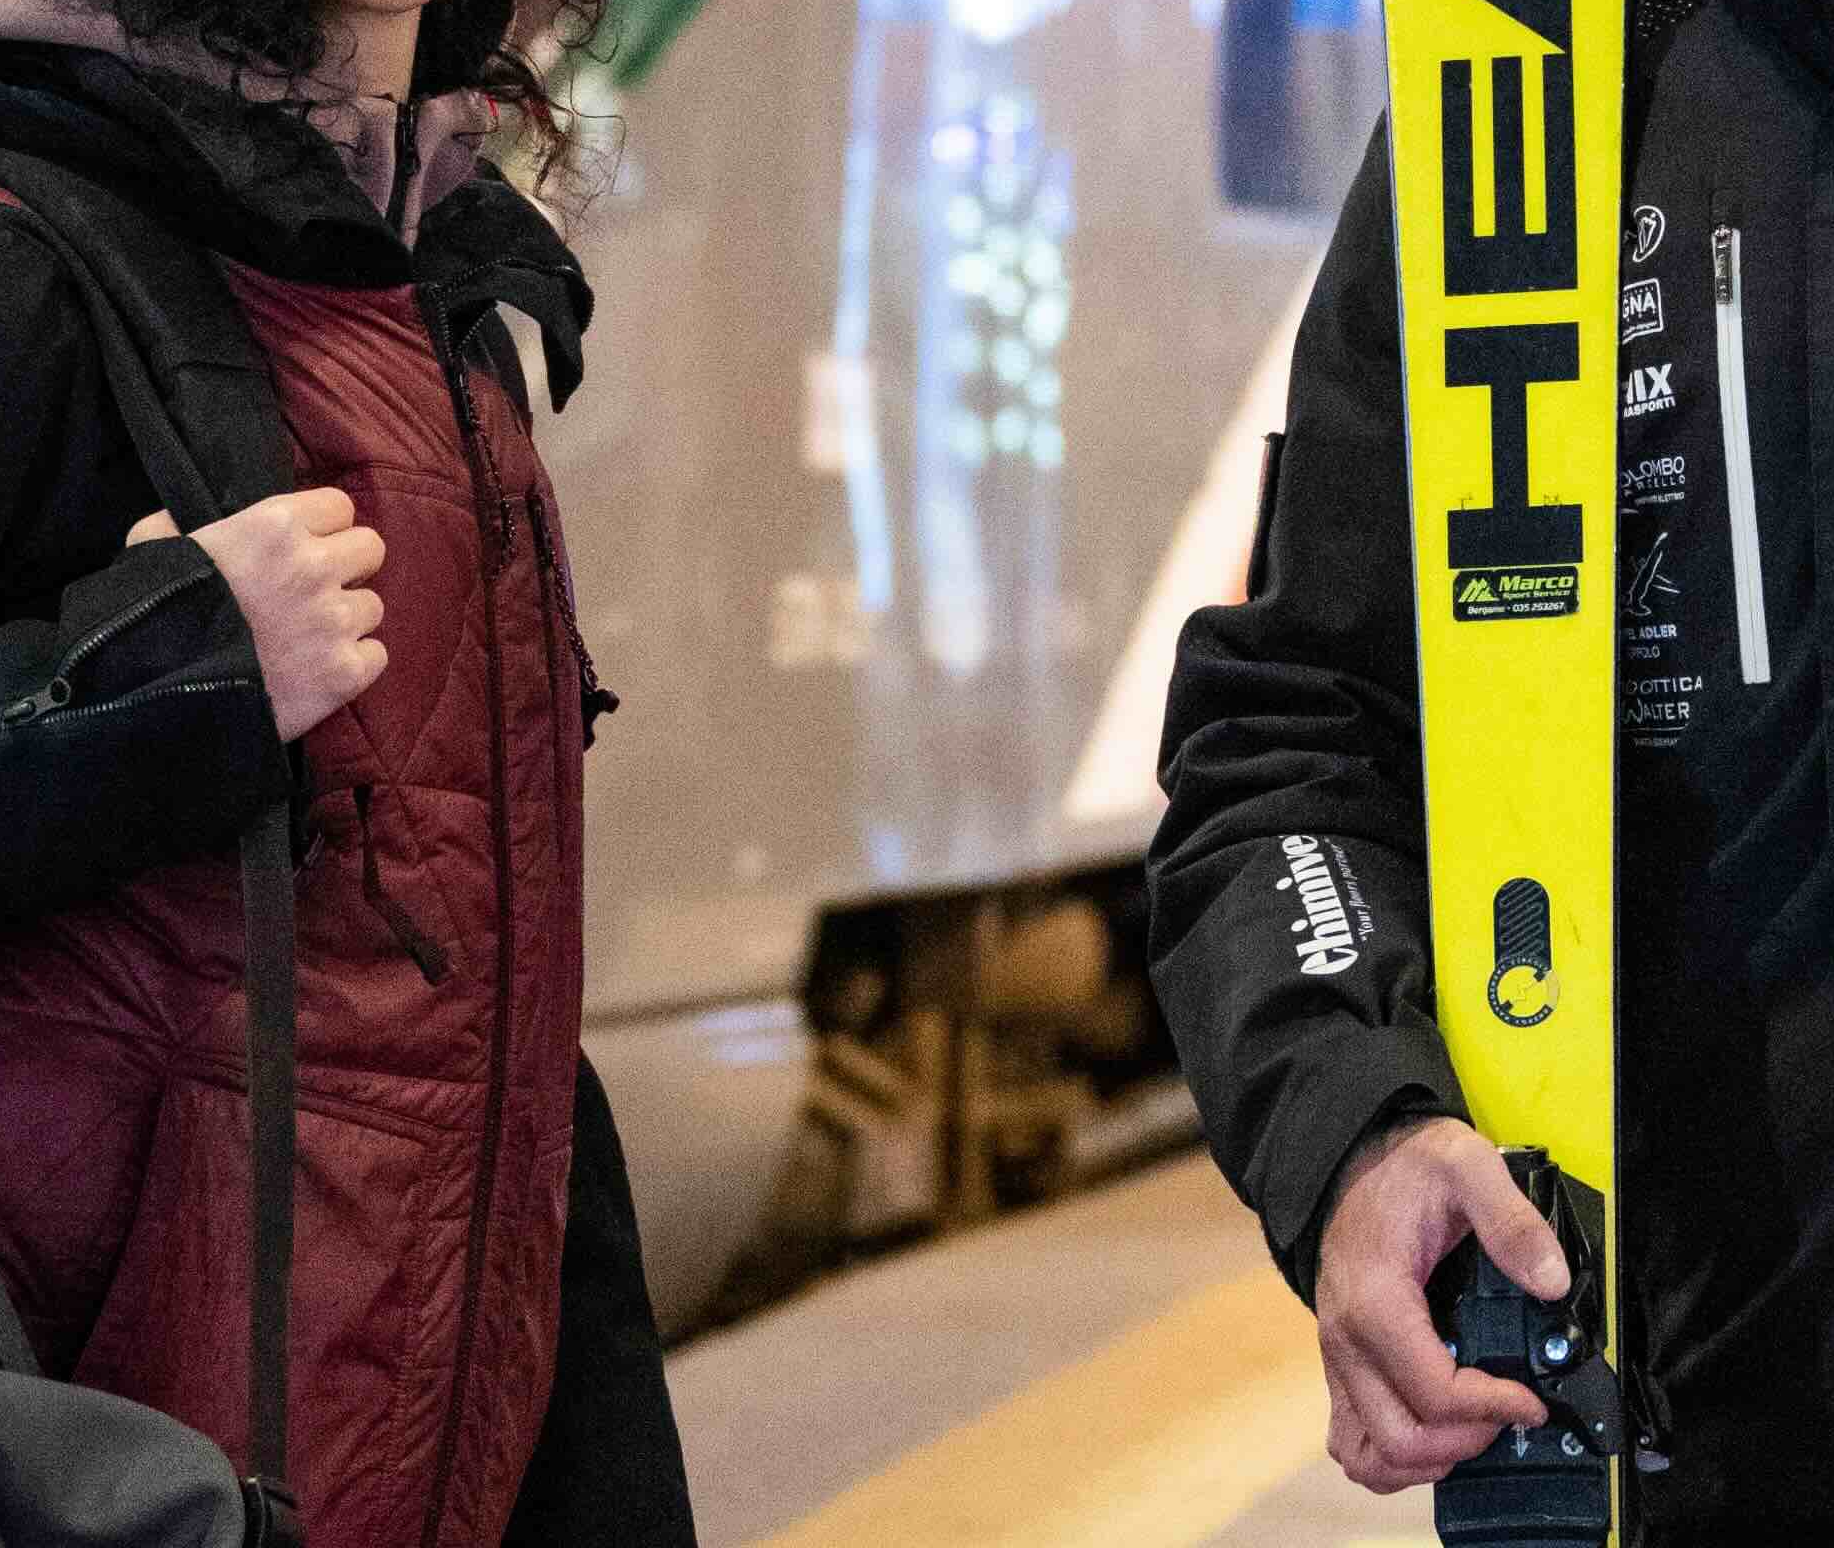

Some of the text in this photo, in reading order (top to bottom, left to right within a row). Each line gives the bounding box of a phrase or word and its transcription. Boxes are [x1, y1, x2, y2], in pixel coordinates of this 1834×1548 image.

[1499, 575, 1574, 592] Marco
[1639, 623, 1678, 640] ADLER
[1276, 835, 1359, 975] Chimive
